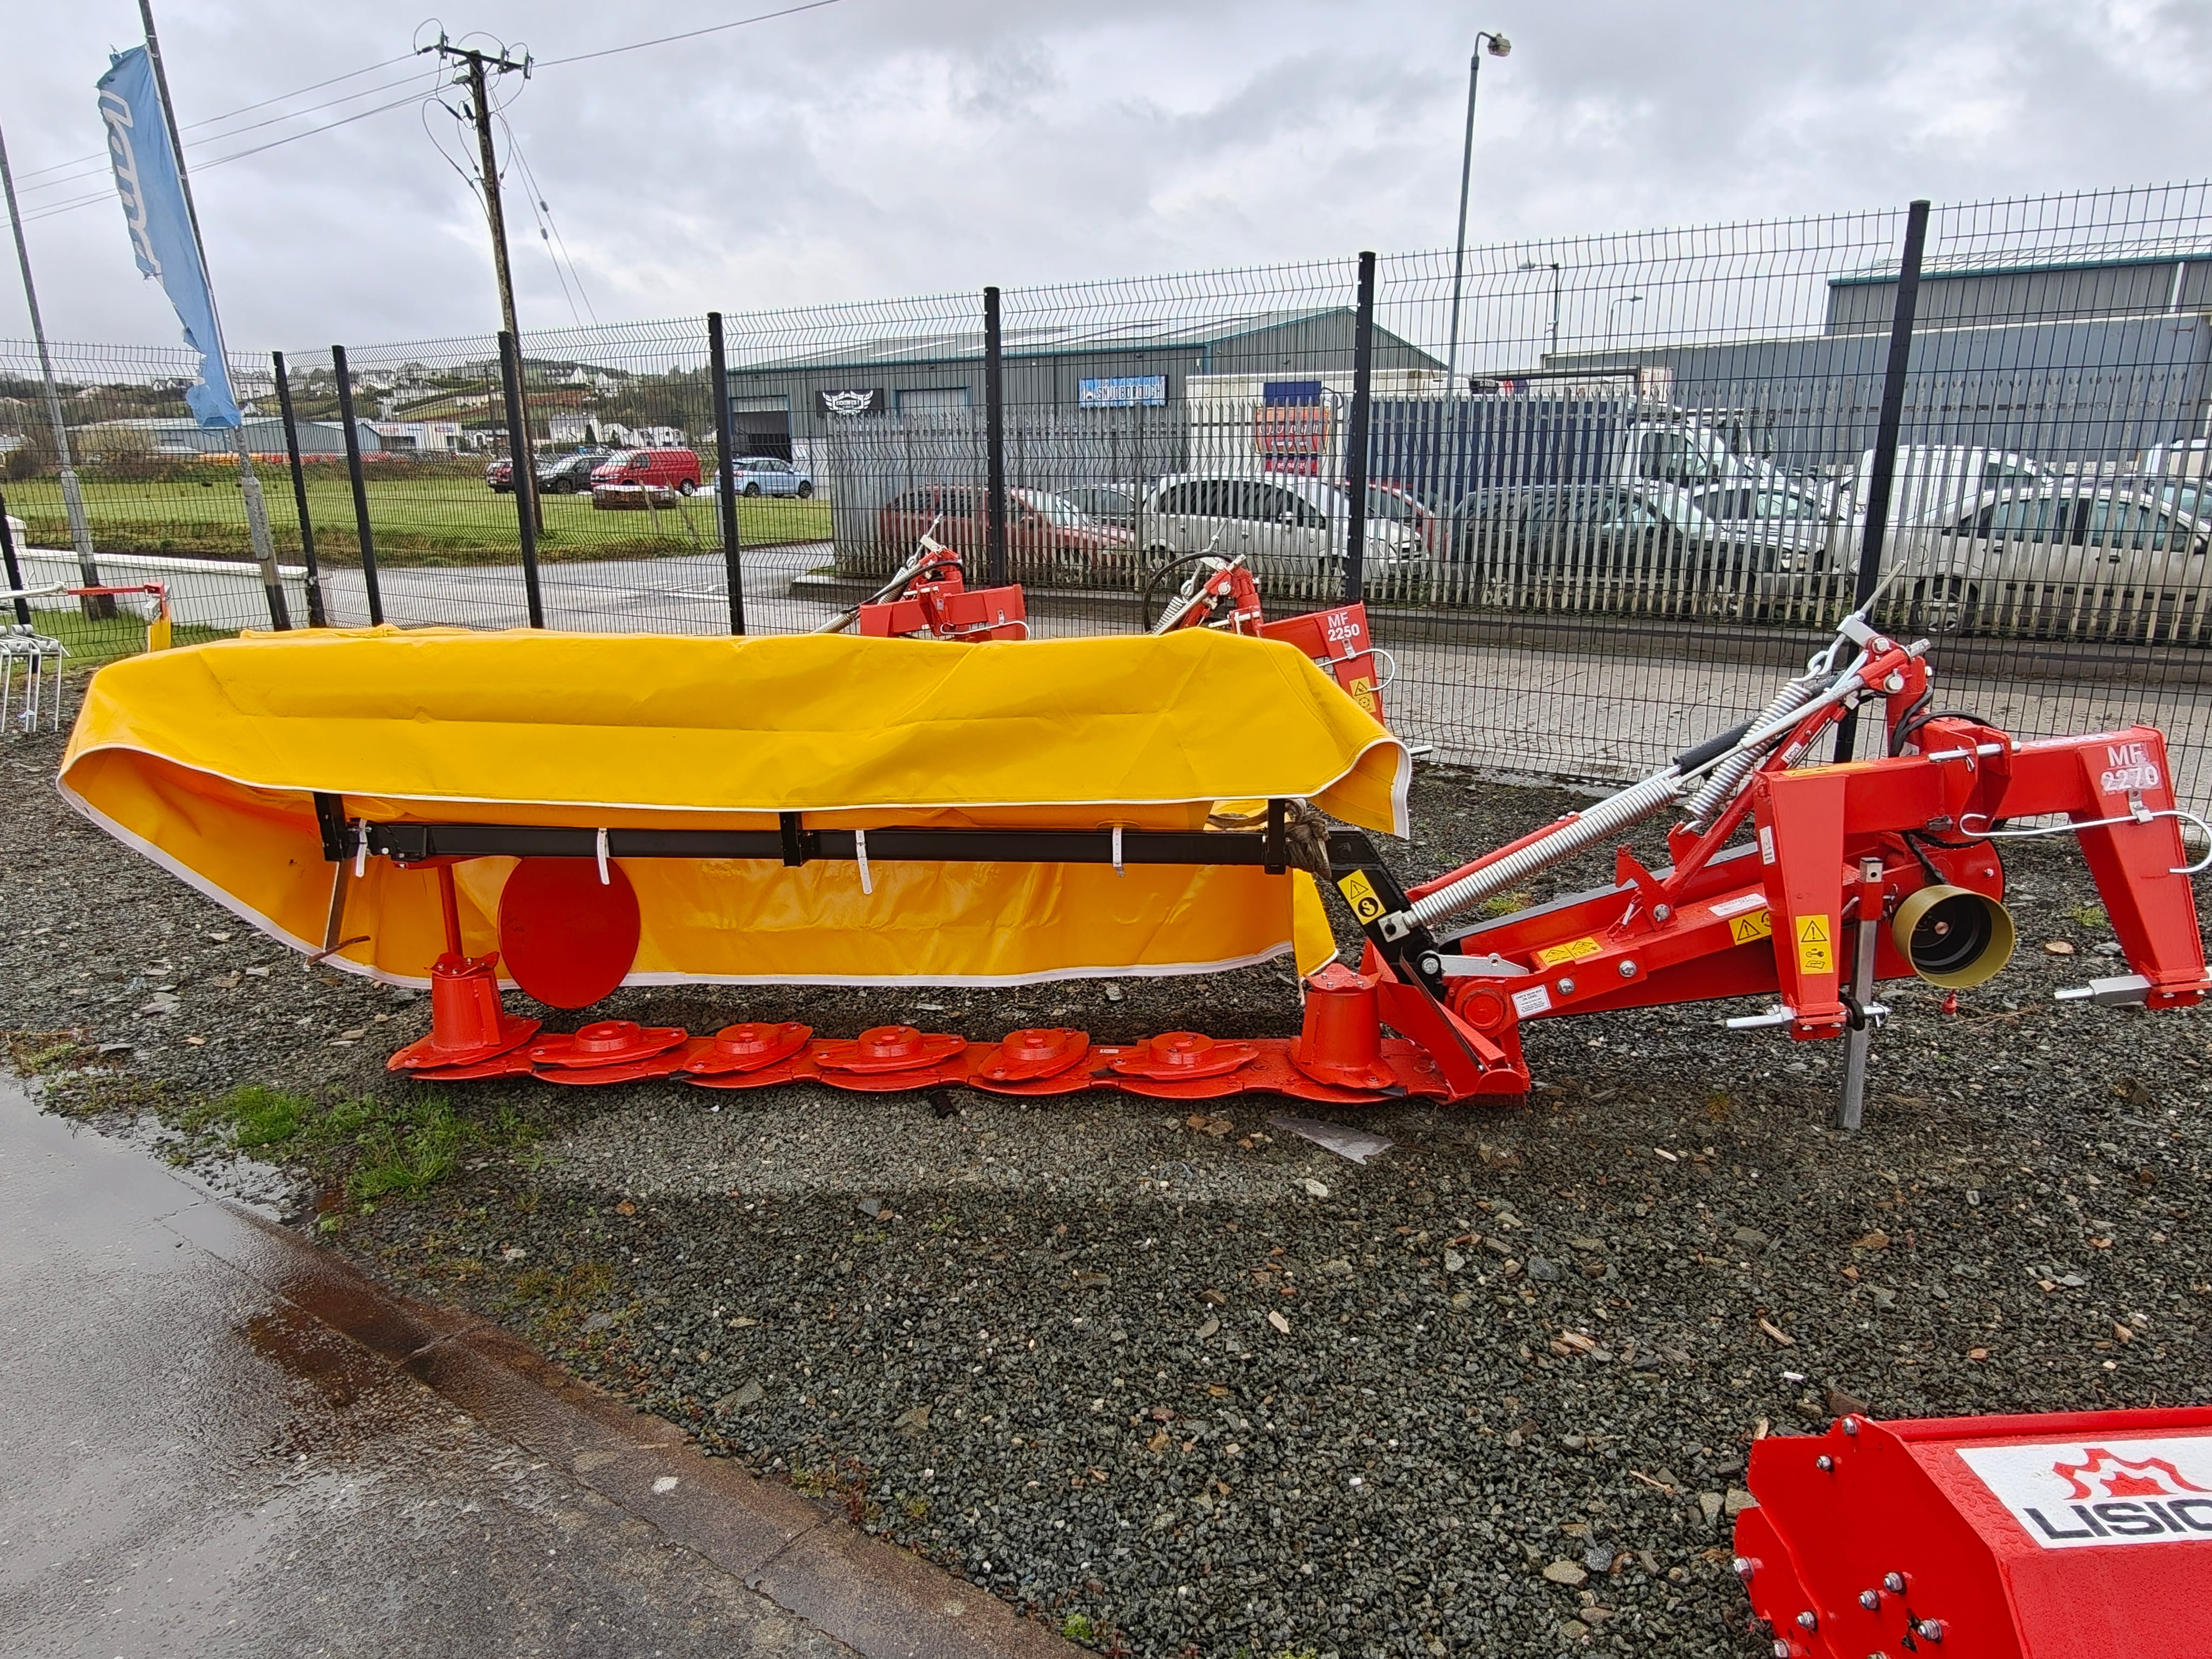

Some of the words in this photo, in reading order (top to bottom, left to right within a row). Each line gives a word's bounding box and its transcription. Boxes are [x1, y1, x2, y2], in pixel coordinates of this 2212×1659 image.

[1327, 611, 1349, 629] MF
[1327, 623, 1360, 642] 2250
[2107, 743, 2143, 767] MF
[2100, 764, 2159, 792] 2270
